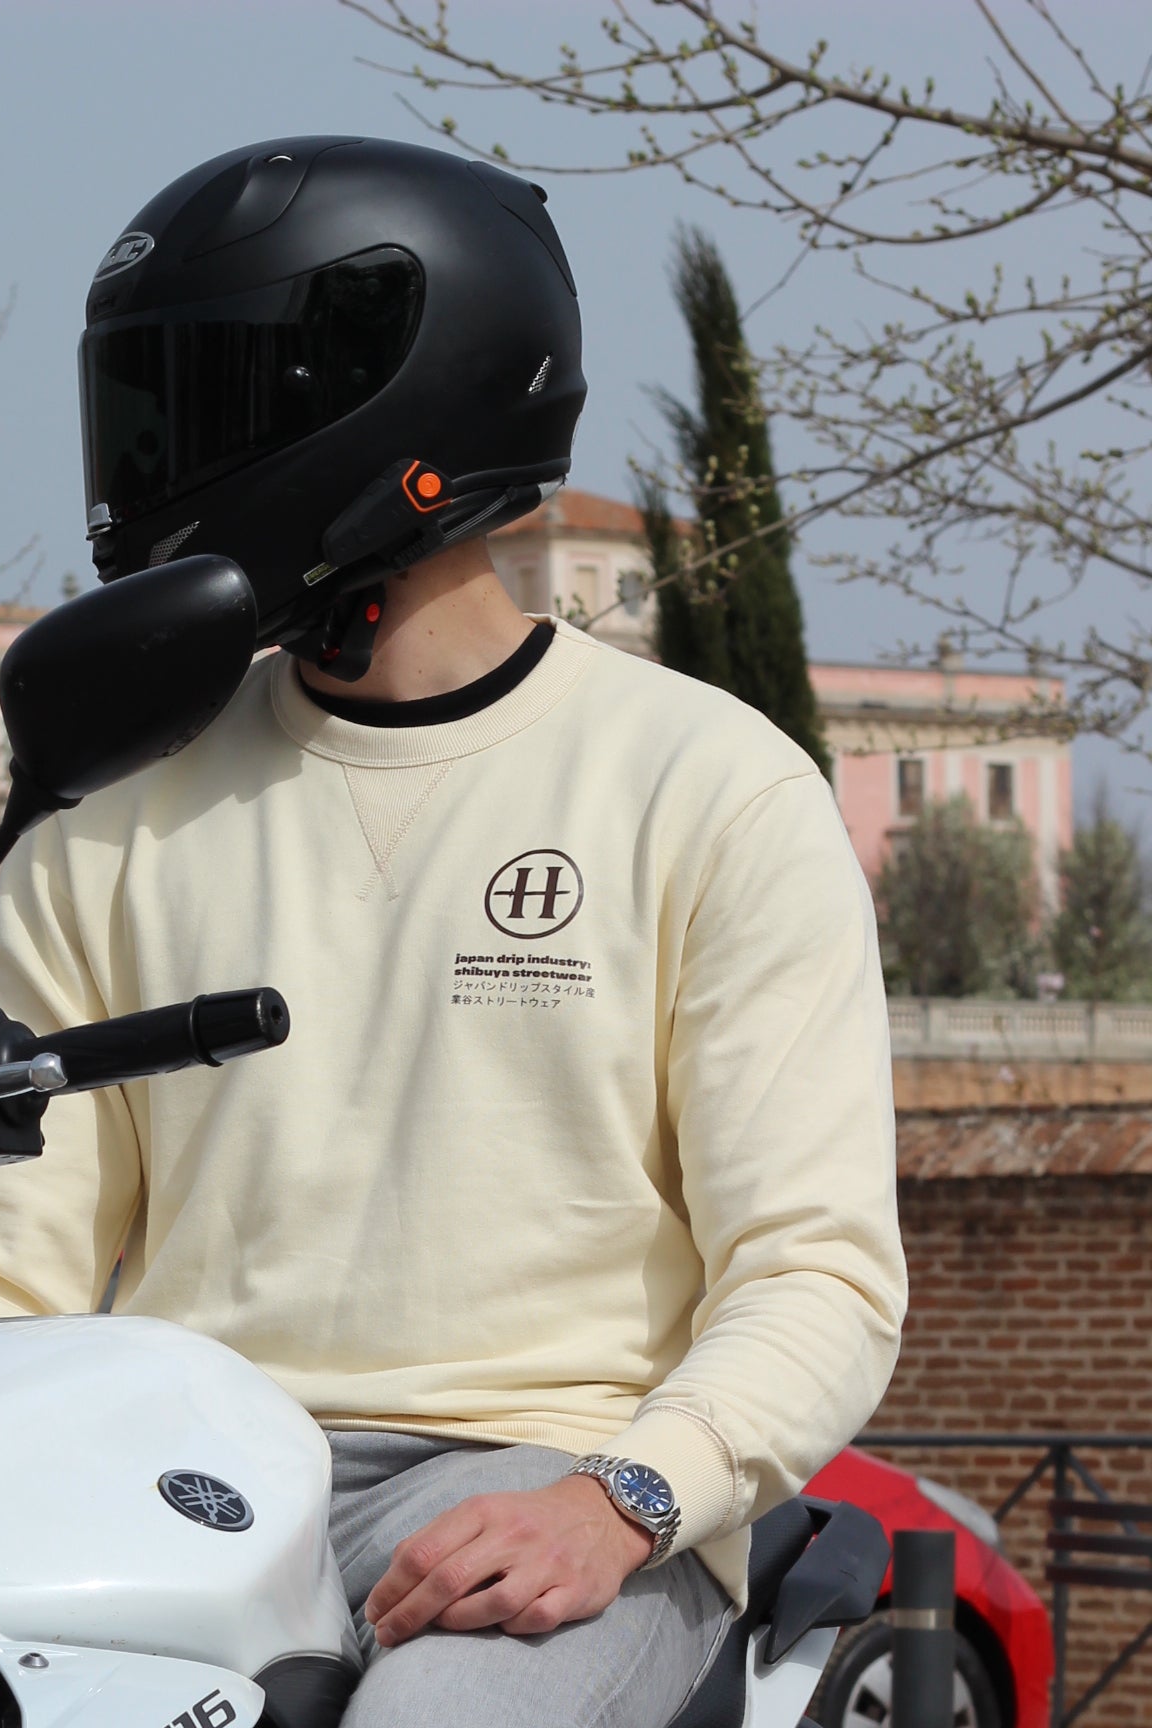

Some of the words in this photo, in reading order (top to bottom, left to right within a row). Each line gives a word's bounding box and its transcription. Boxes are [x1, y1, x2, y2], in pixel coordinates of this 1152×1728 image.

[454, 953, 495, 965] japan
[496, 954, 525, 966] drip
[454, 967, 510, 979] shibuya
[512, 968, 593, 982] streetwear
